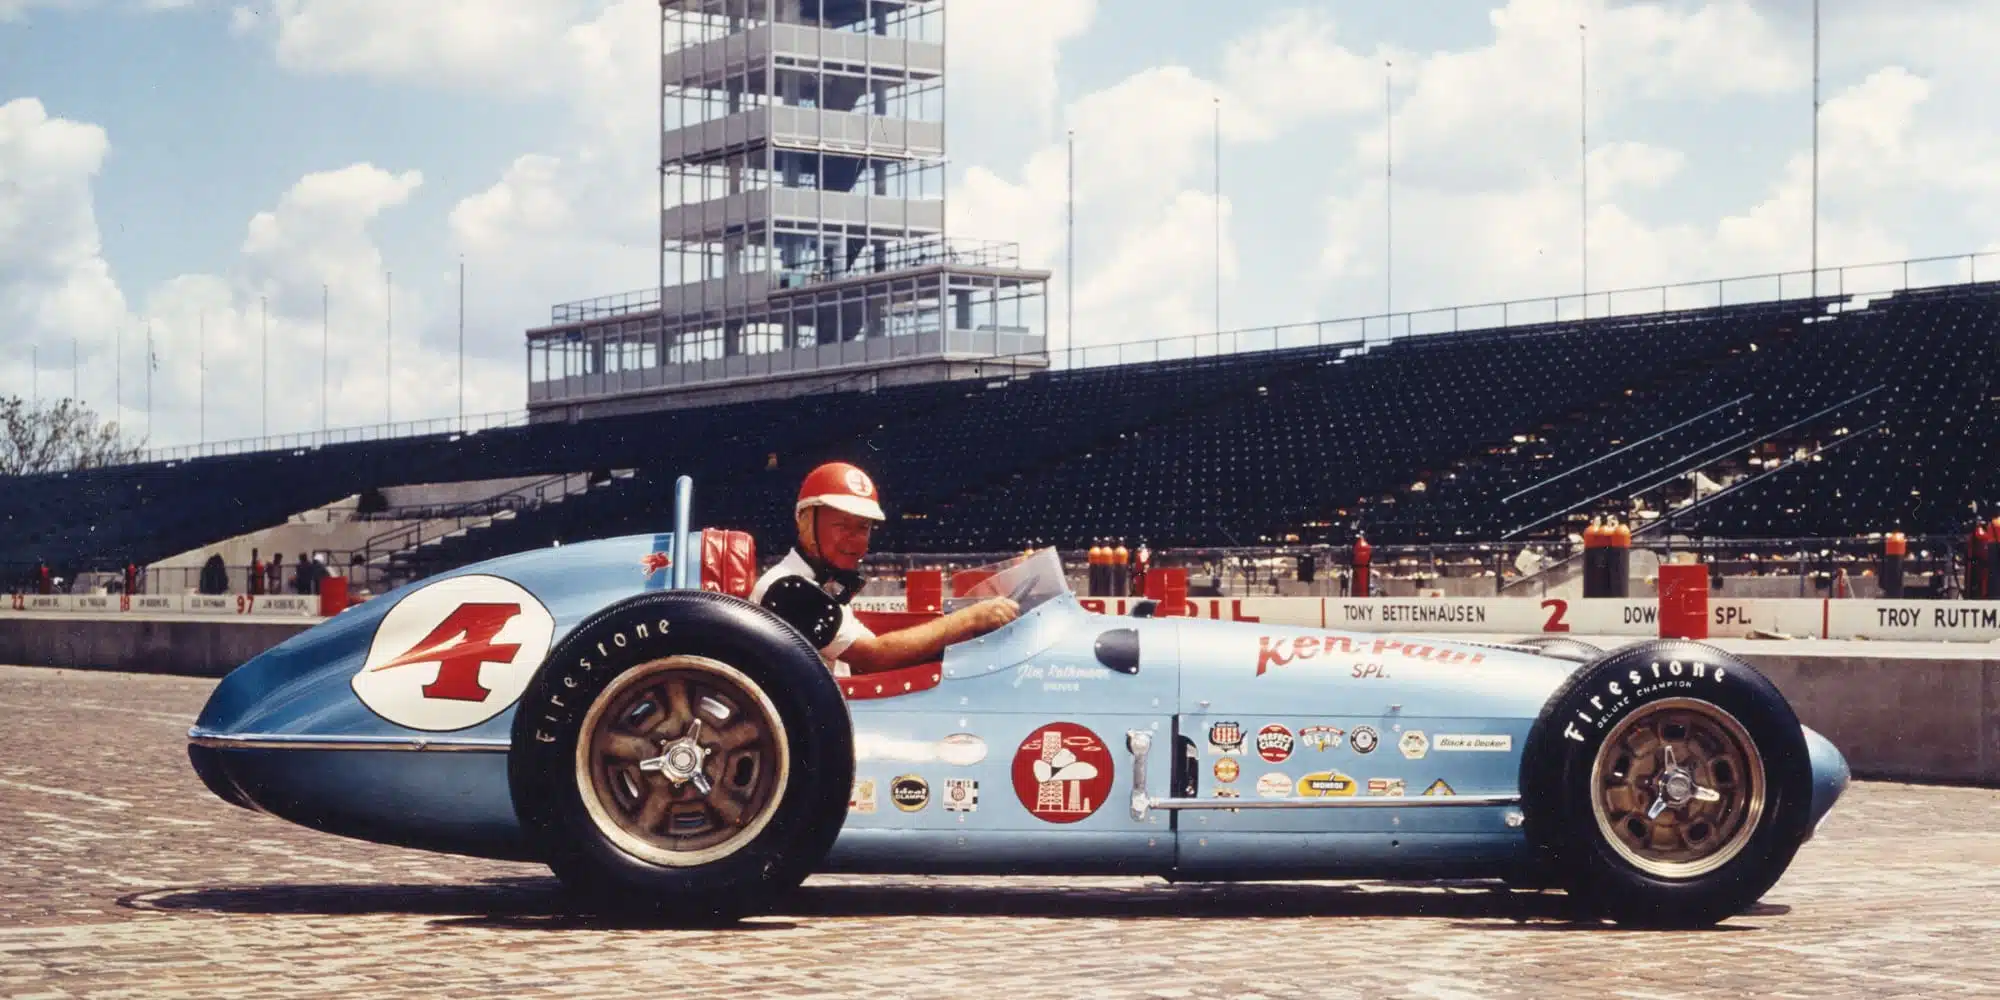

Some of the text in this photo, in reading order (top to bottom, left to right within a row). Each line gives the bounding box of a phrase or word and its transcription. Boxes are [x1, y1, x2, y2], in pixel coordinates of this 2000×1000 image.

[236, 595, 254, 615] 97
[1343, 604, 1485, 623] TONY BETTENHAUSEN
[1540, 599, 1570, 632] 2
[1624, 606, 1752, 625] DOW SPL.
[1877, 608, 2000, 628] TROY RUTTM
[371, 603, 521, 702] 4
[535, 618, 670, 743] Firestone
[1351, 663, 1391, 679] SPL.
[1563, 659, 1726, 742] Firestone
[1597, 680, 1692, 729] DELUXE CHAMPION
[1303, 733, 1343, 748] BEAR
[1440, 738, 1465, 747] Black
[1474, 739, 1507, 748] Decker
